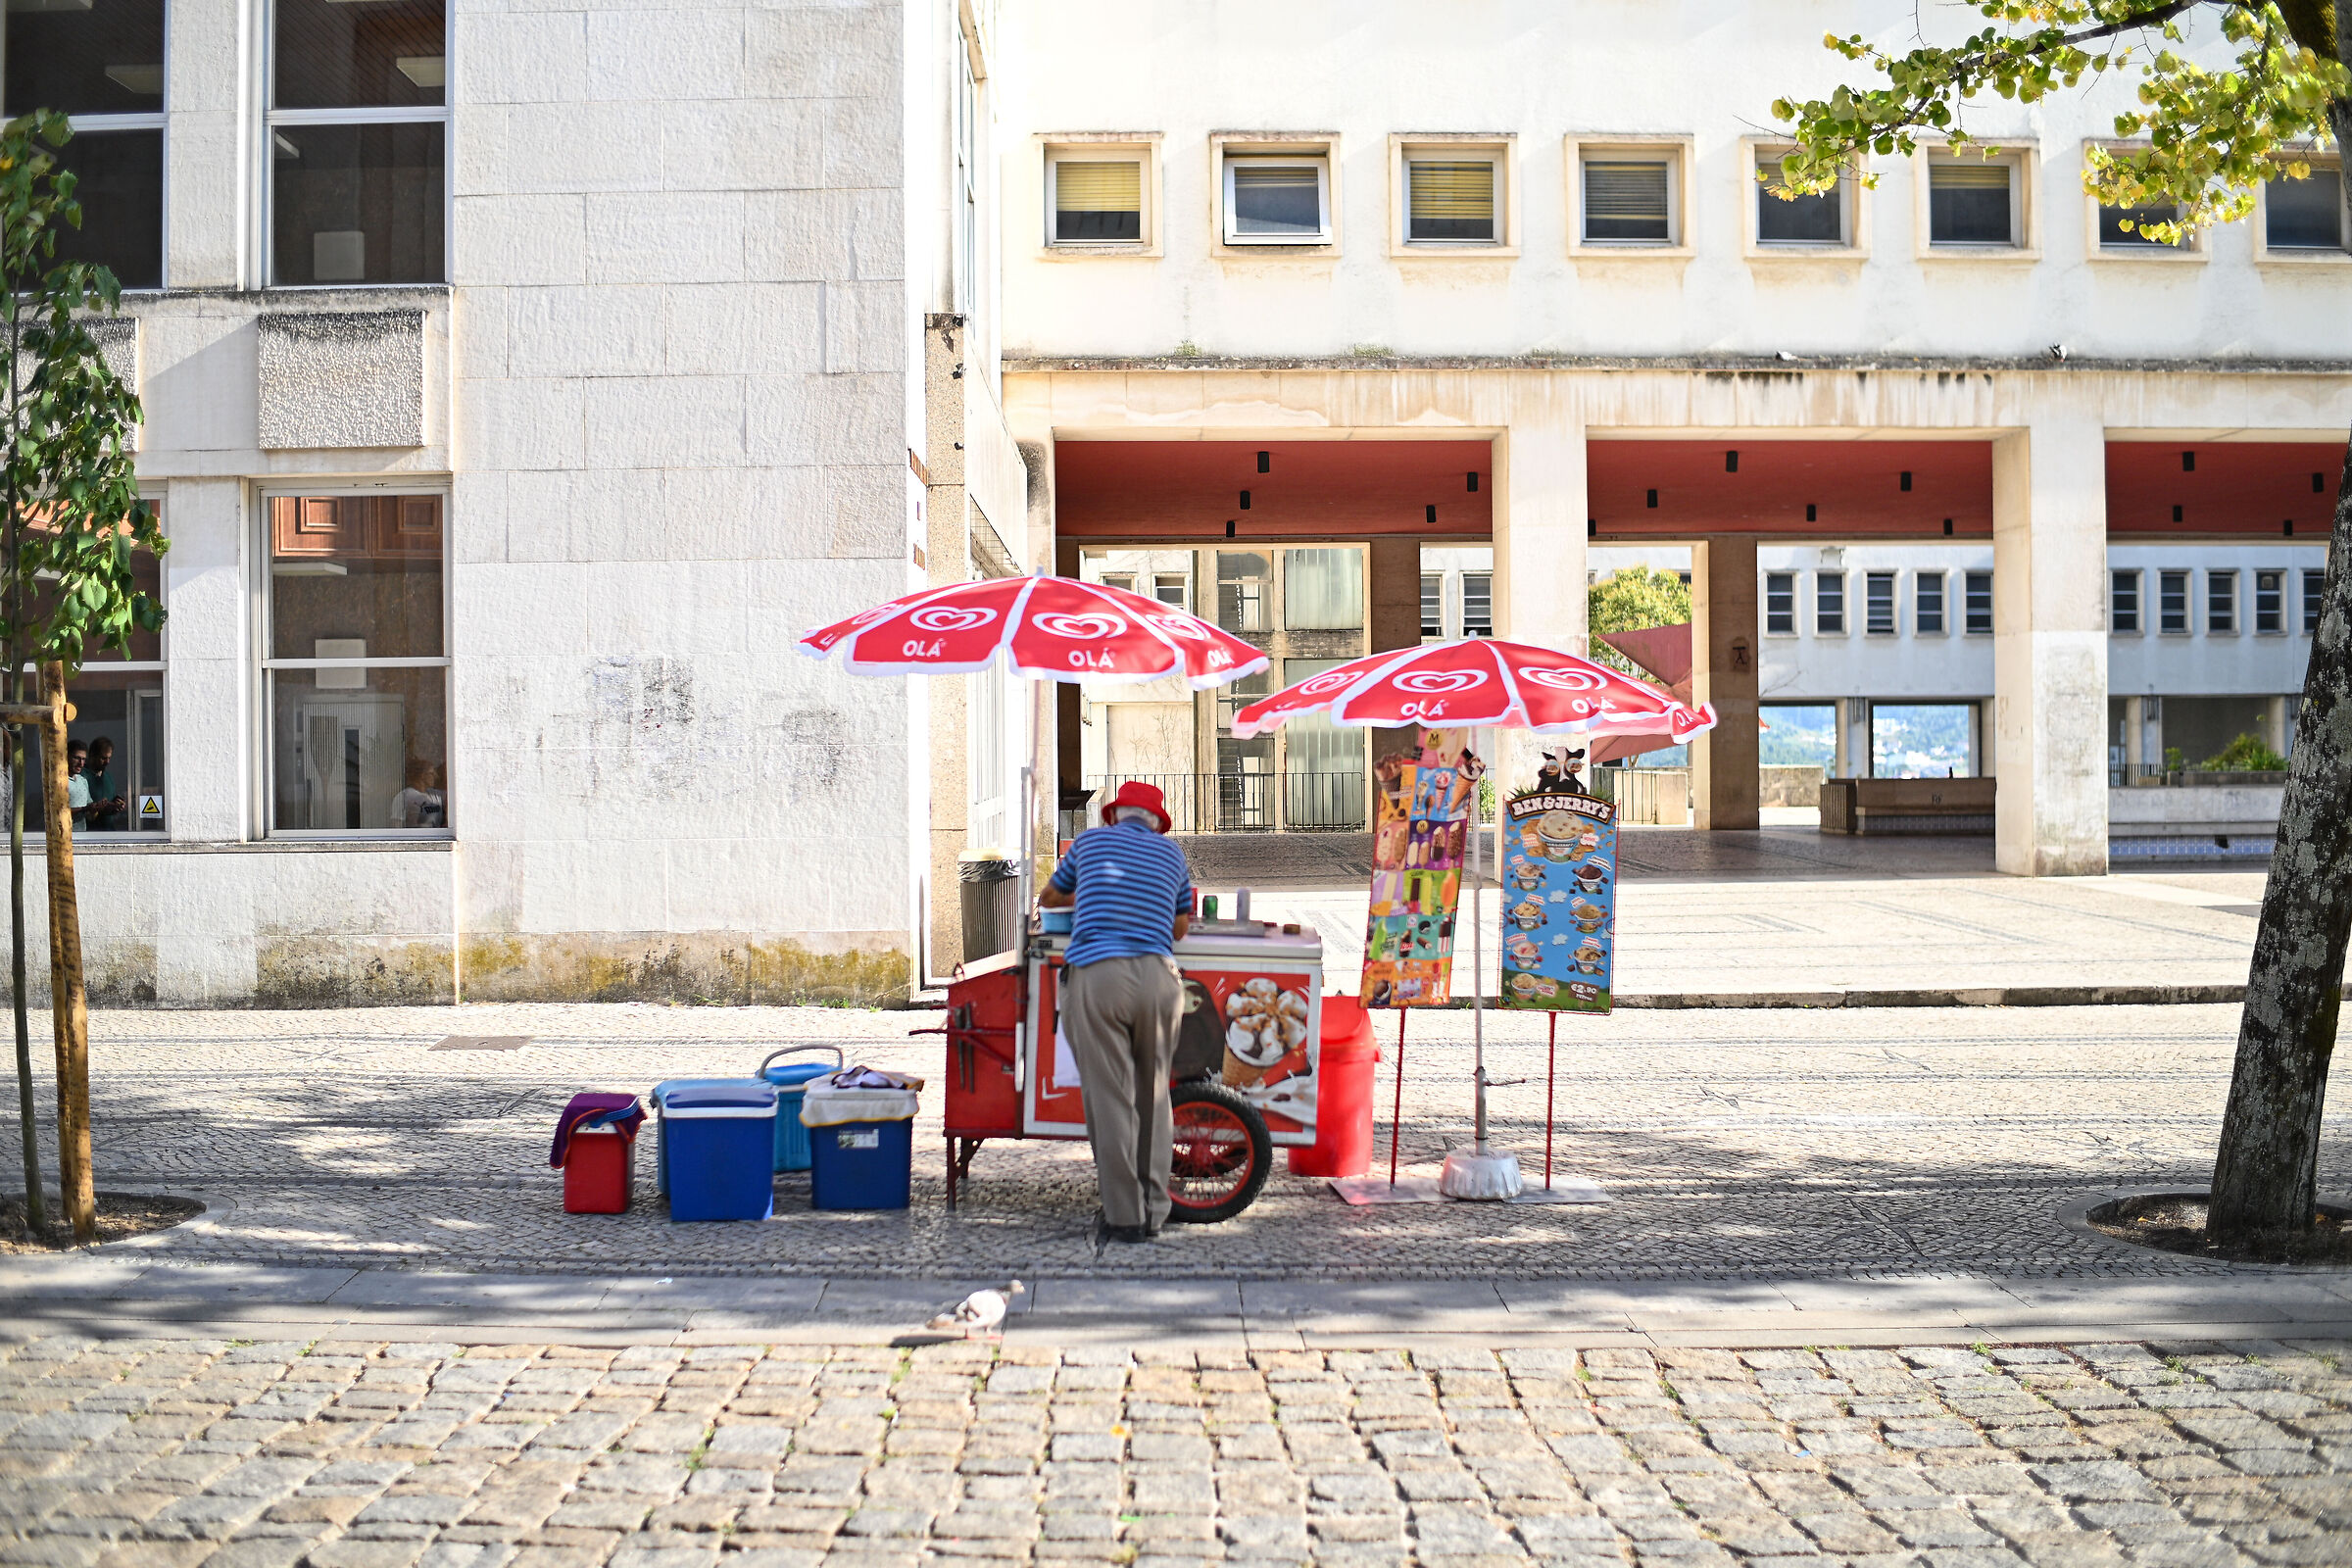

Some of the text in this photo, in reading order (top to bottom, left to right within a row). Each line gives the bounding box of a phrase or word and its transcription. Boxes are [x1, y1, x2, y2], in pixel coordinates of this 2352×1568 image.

[903, 638, 942, 657] OLÁ
[1067, 647, 1114, 668] OLÁ
[1400, 700, 1445, 716] OLÁ
